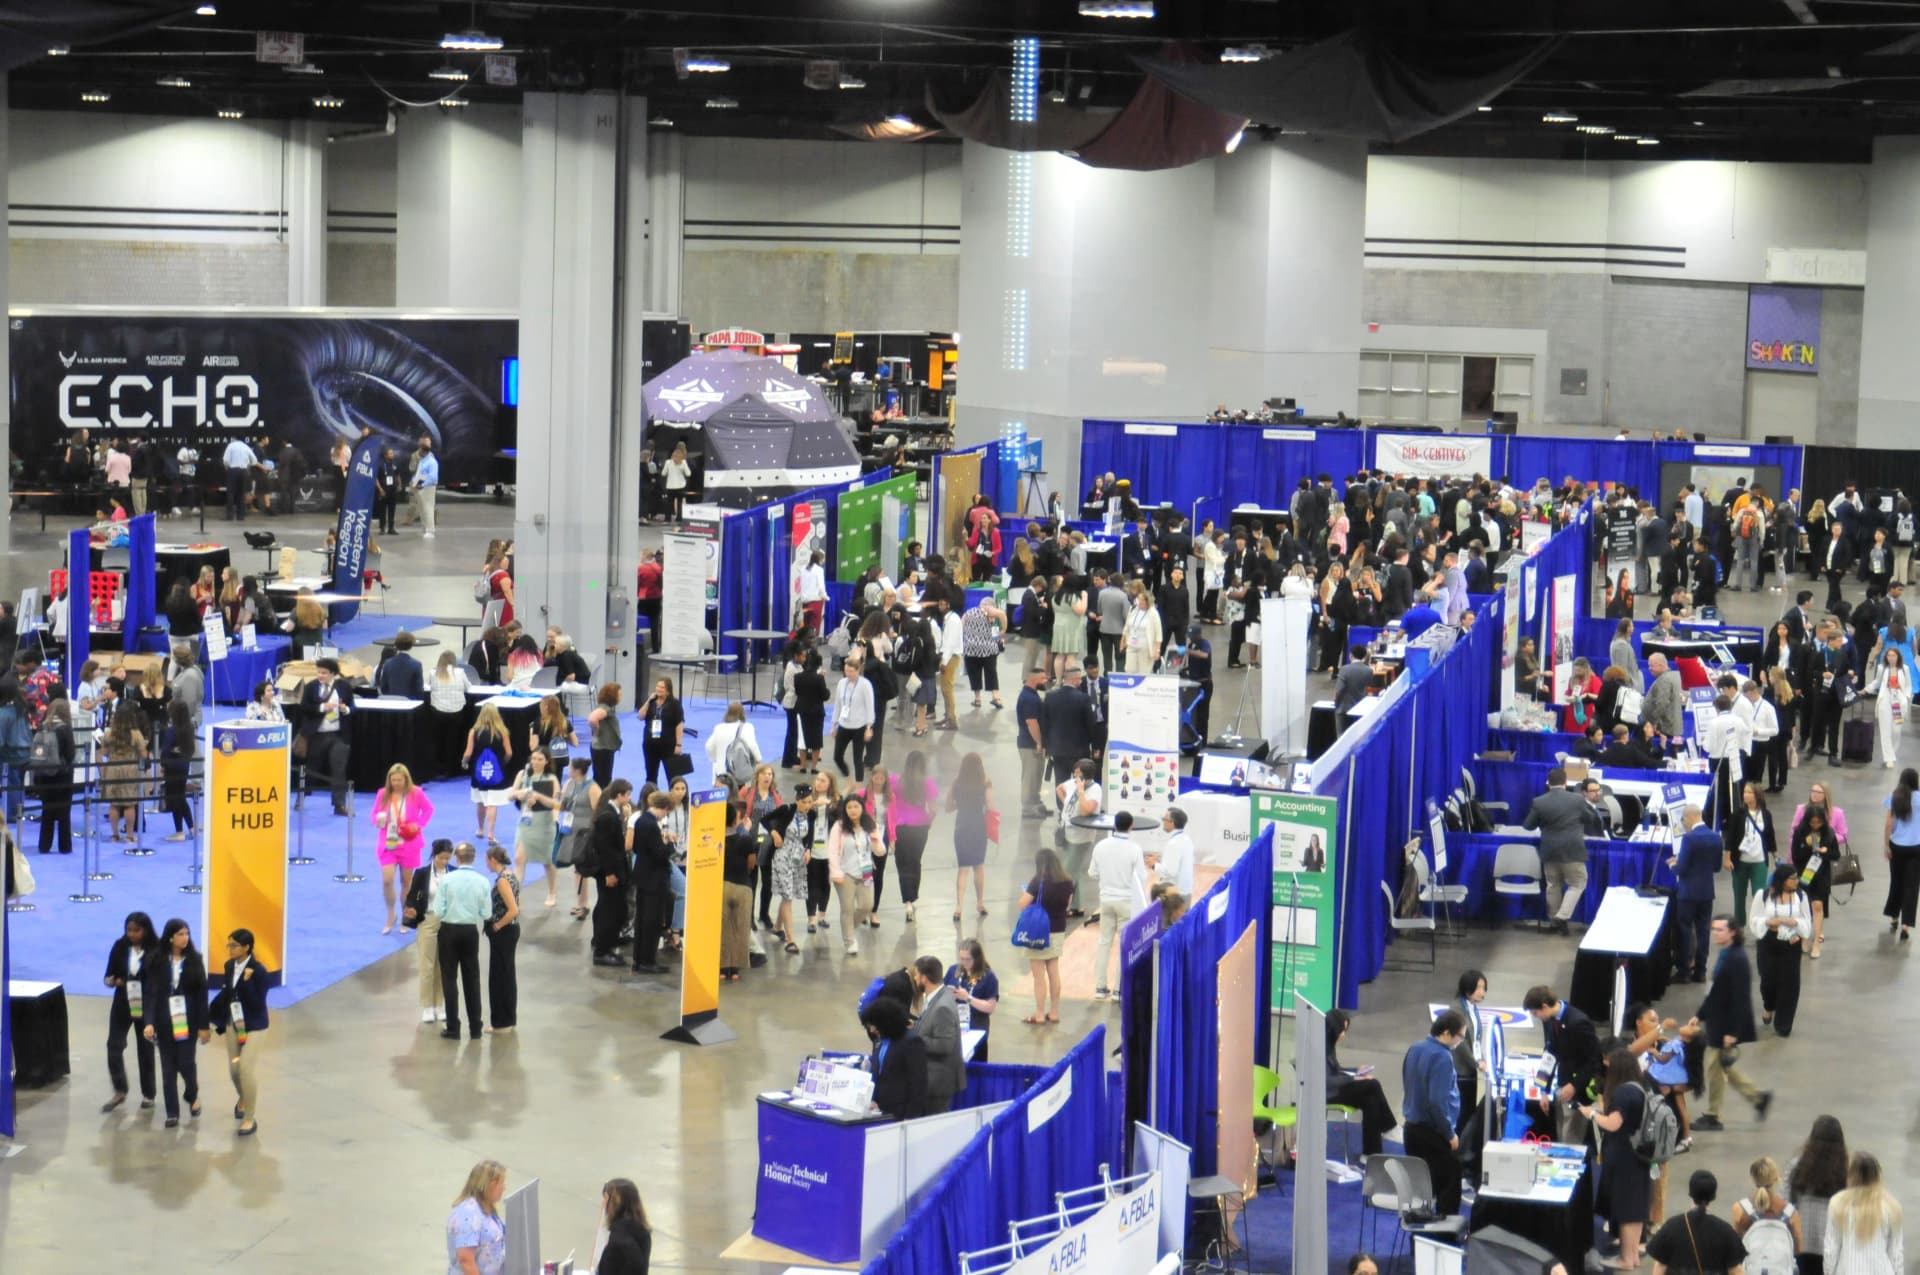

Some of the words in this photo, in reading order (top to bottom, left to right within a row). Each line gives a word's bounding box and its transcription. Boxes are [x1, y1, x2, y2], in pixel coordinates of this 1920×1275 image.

[708, 331, 731, 344] PAPA
[203, 355, 219, 366] AIR
[1751, 340, 1815, 365] SHAKEN
[356, 462, 373, 478] FBLA
[337, 509, 357, 567] Region
[350, 508, 369, 578] Western
[267, 732, 286, 743] FBLA
[227, 786, 278, 804] FBLA
[1274, 799, 1326, 816] Accounting
[231, 813, 274, 829] HUB
[764, 1163, 792, 1184] Honor
[792, 1163, 828, 1184] Technical
[1129, 1188, 1154, 1226] FBLA
[1060, 1232, 1086, 1272] FBLA
